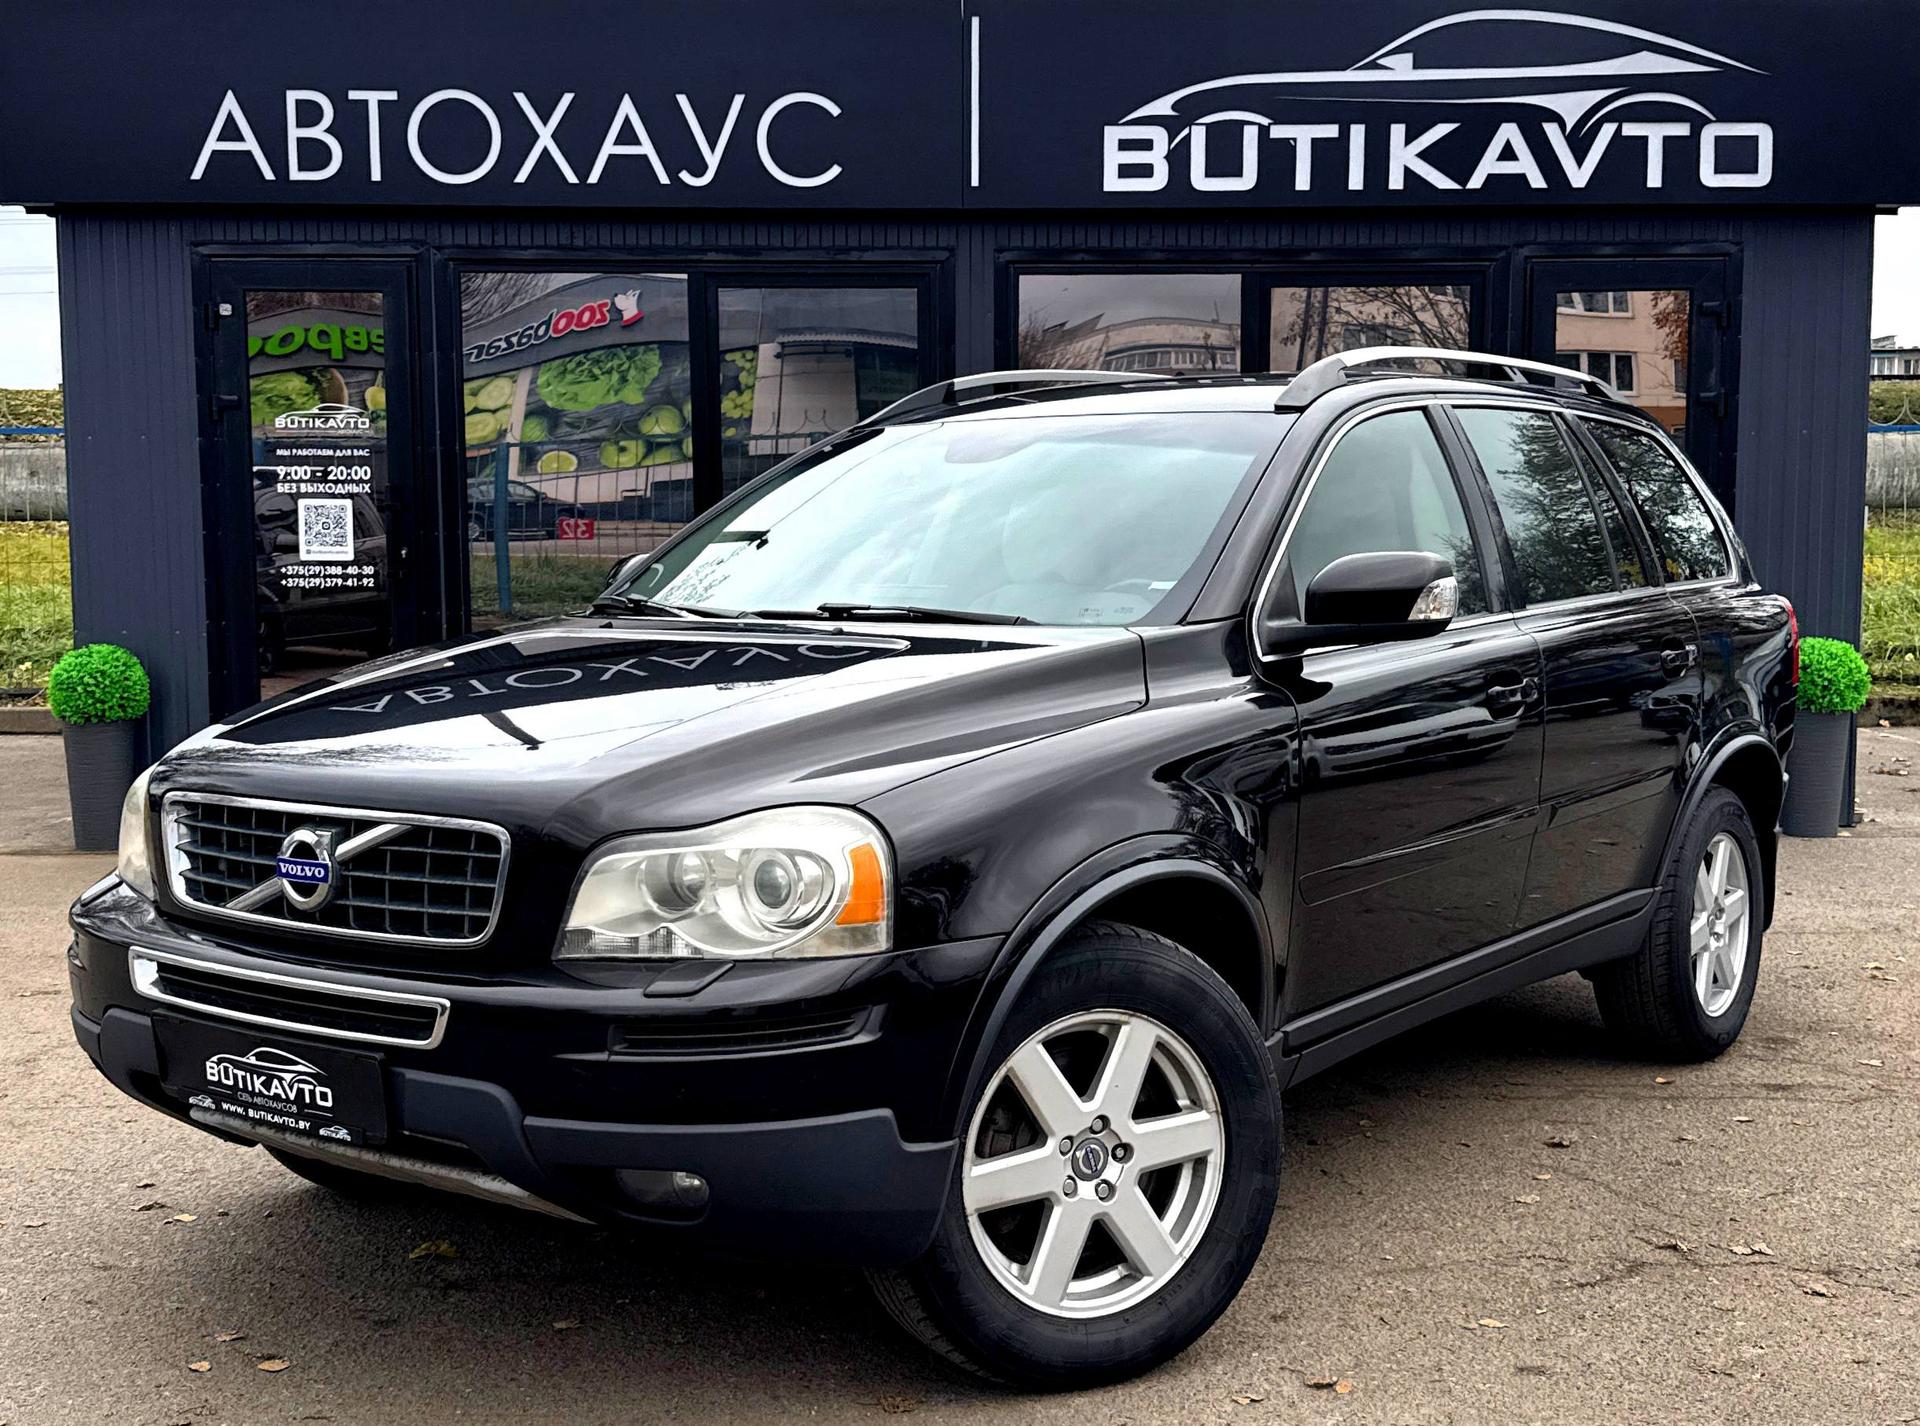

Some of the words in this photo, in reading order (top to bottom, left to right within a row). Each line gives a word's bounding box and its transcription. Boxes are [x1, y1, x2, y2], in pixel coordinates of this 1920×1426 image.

[190, 88, 844, 188] АВТОХАУС
[1102, 121, 1774, 192] BUTIKAVTO
[274, 417, 370, 429] BUTIKAVTO
[276, 448, 291, 456] МЫ
[292, 448, 334, 456] РАБОТАЕМ
[334, 449, 352, 457] ДЛЯ
[353, 448, 371, 456] ВАС
[277, 465, 311, 480] 9:00
[327, 465, 371, 480] 20:00
[277, 482, 297, 494] БЕЗ
[300, 482, 371, 495] ВЫХОДНЫХ
[280, 565, 375, 577] +375(29)388-40-30
[280, 577, 375, 589] +375(29)379-41-92
[278, 862, 325, 878] VOLVO
[206, 1061, 333, 1107] BUTIKAVTO
[248, 1108, 311, 1131] BUTIKAVTO.BY
